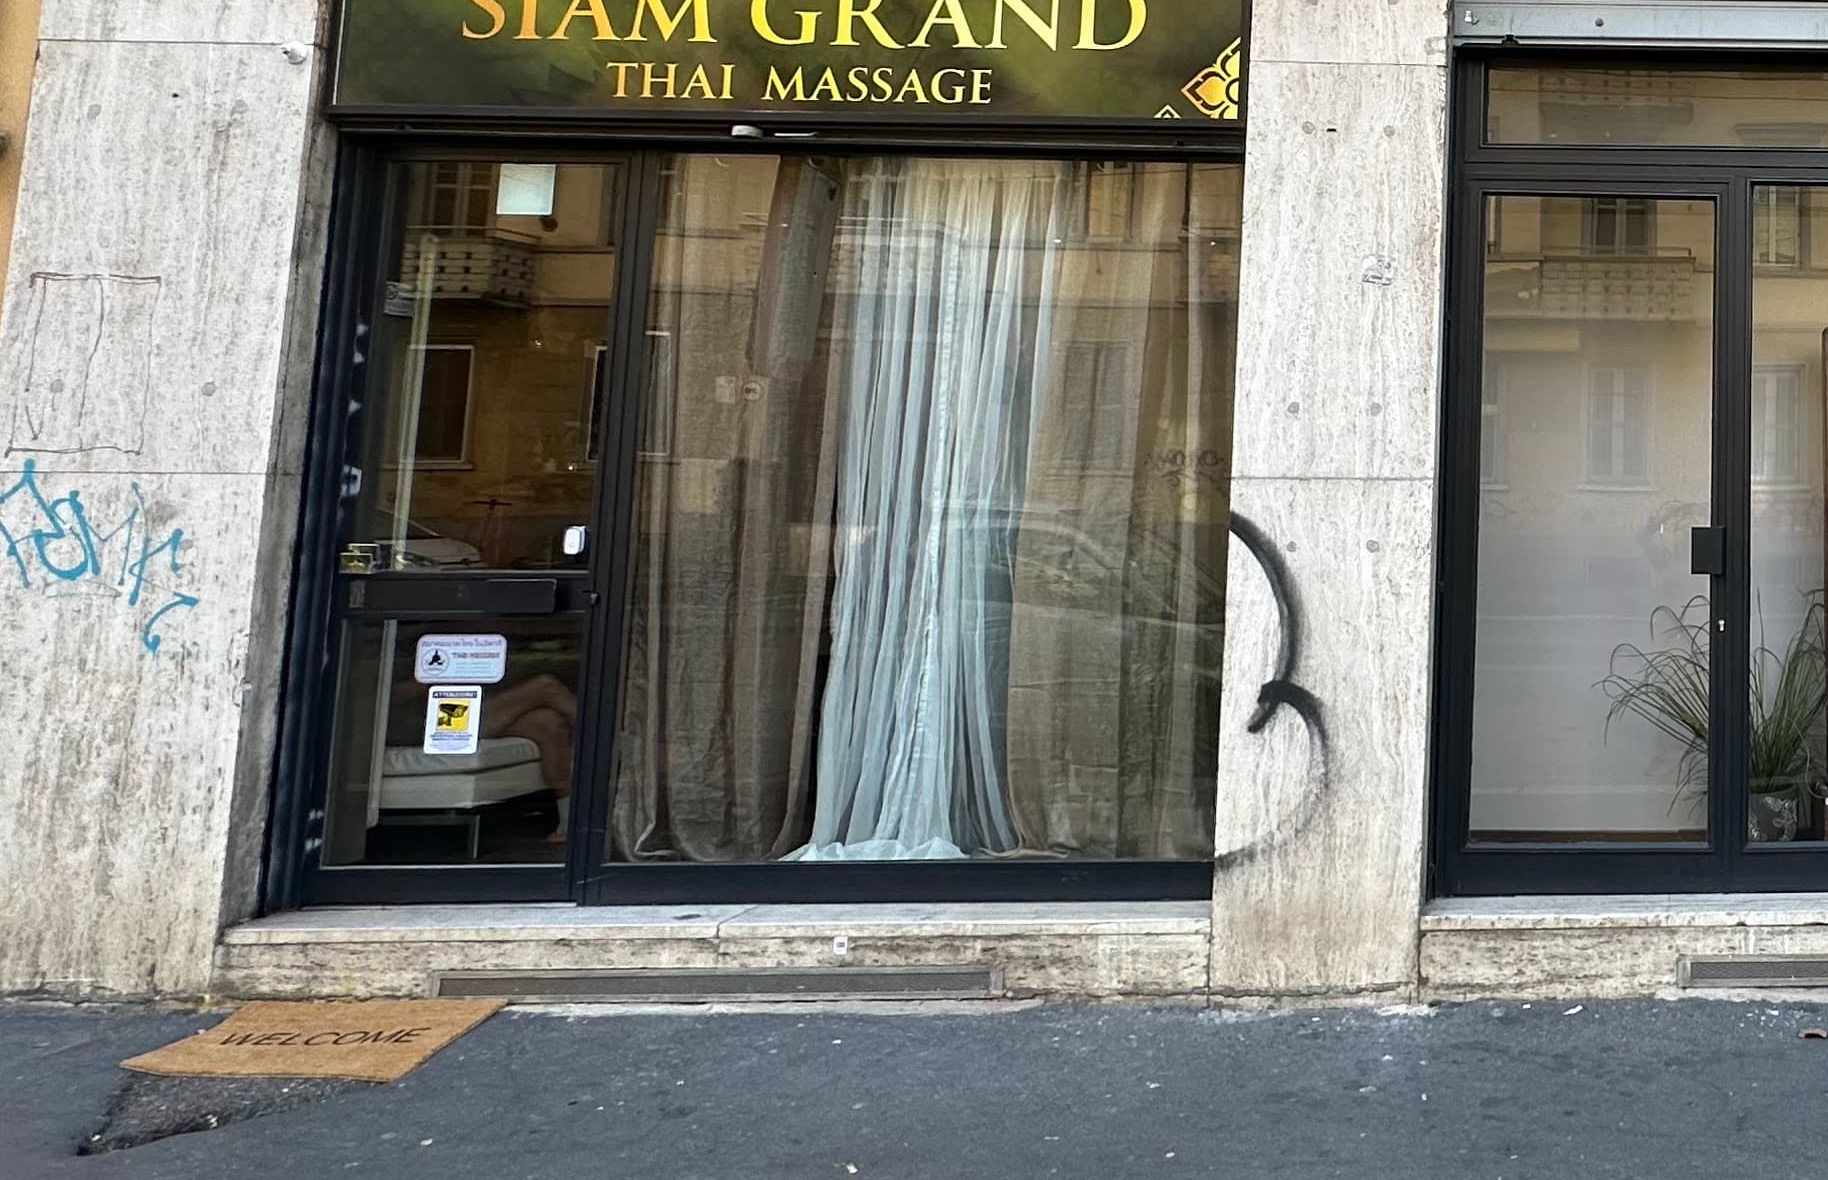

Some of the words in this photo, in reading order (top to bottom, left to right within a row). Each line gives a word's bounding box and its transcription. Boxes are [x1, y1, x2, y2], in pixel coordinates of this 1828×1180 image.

[606, 62, 736, 99] THAI
[760, 66, 993, 104] MASSAGE
[219, 1027, 431, 1046] WELCOME
